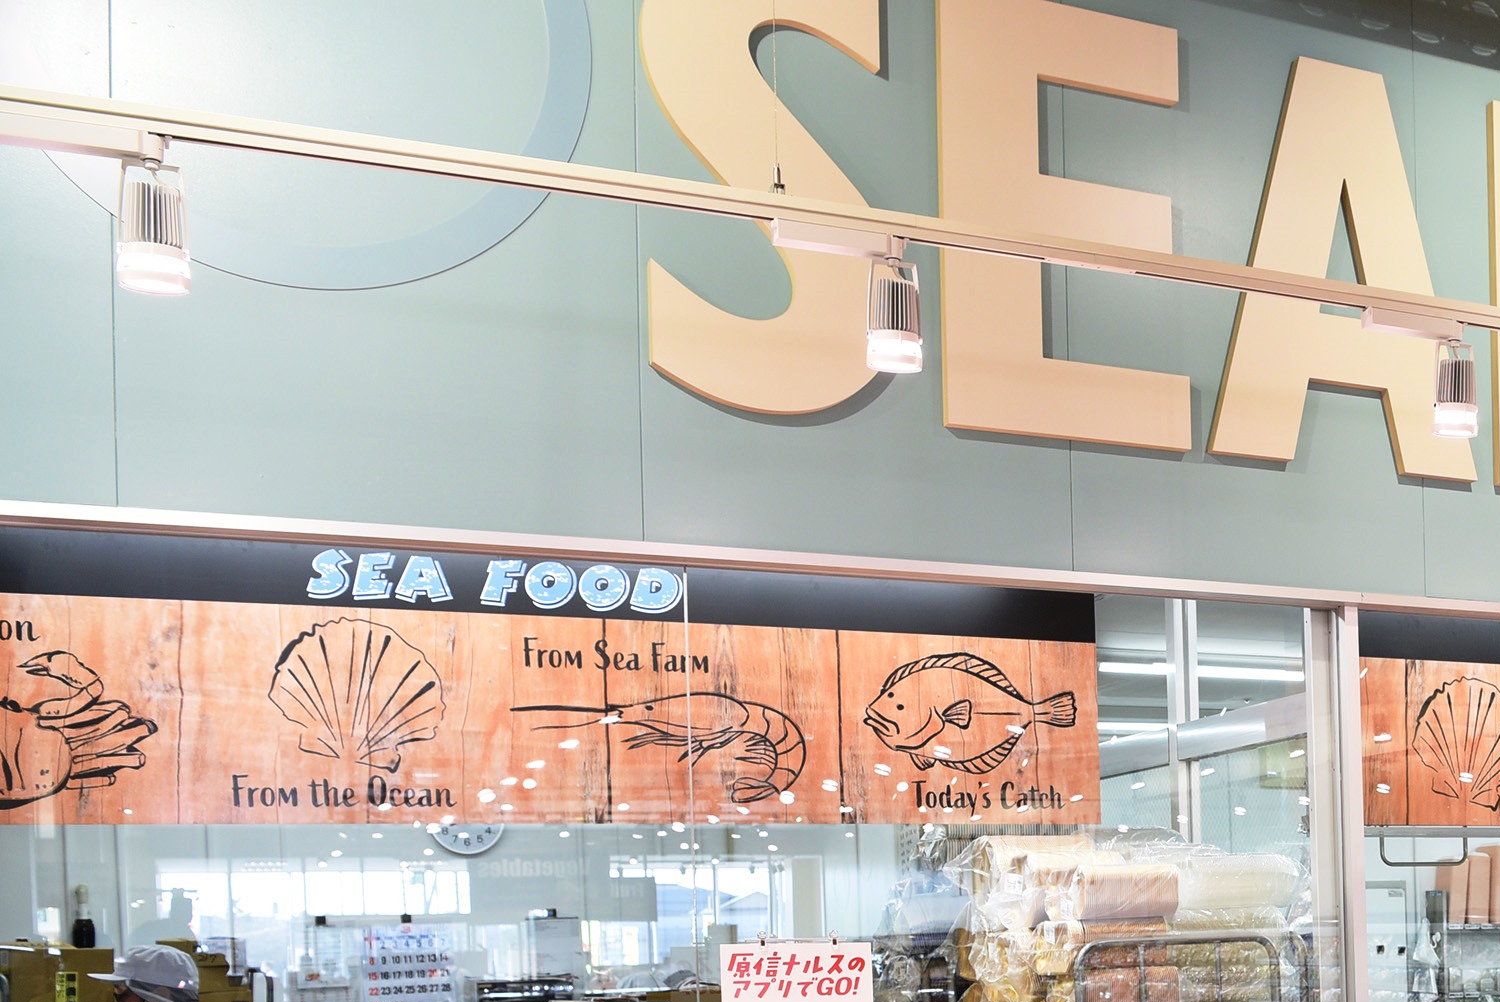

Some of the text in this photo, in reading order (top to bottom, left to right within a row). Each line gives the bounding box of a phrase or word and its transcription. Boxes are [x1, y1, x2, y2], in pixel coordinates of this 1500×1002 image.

[306, 549, 686, 615] SEA FOOD
[522, 636, 710, 675] From Sea Farm
[231, 775, 458, 808] From the Ocean
[911, 780, 1066, 818] Today's Catch
[391, 956, 401, 964] 10
[403, 955, 413, 963] 11
[415, 954, 425, 963] 12
[427, 953, 437, 962] 13
[727, 952, 866, 978] 原信ナルスの
[368, 972, 378, 980] 15
[380, 971, 390, 980] 16
[392, 971, 401, 980] 17
[404, 970, 414, 979] 18
[416, 969, 426, 978] 19
[369, 983, 452, 996] 22 23 24 25 26 27 28
[733, 977, 860, 999] アプリでGO!
